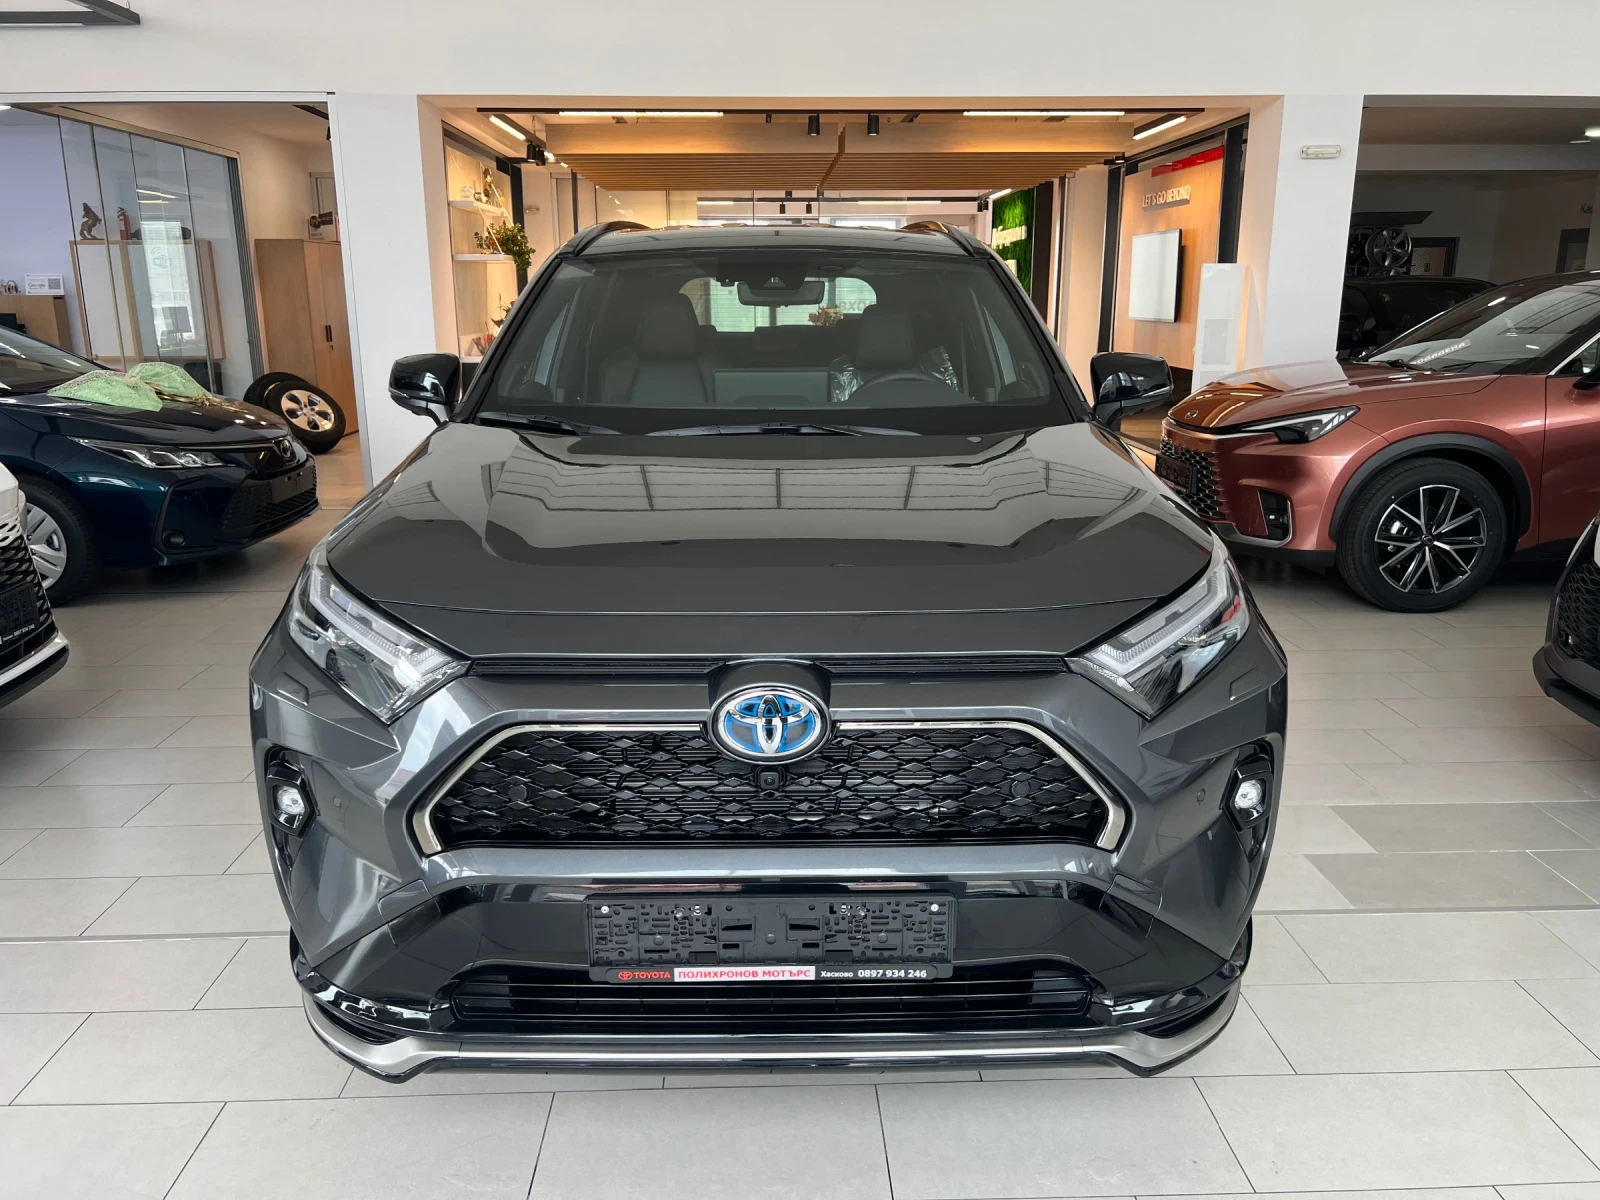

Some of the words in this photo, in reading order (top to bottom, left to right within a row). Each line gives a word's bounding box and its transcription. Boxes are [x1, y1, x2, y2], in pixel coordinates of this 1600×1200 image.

[1156, 190, 1167, 205] GO
[1166, 185, 1191, 203] BEYOND
[840, 300, 876, 312] ВХО
[633, 971, 672, 979] TOYOTA
[678, 970, 759, 979] ПОЛИХРОНОВ
[762, 969, 812, 978] МОТЪРС
[820, 970, 854, 978] Хасково
[857, 969, 884, 978] 0897
[885, 969, 906, 978] 934
[907, 969, 927, 978] 246
